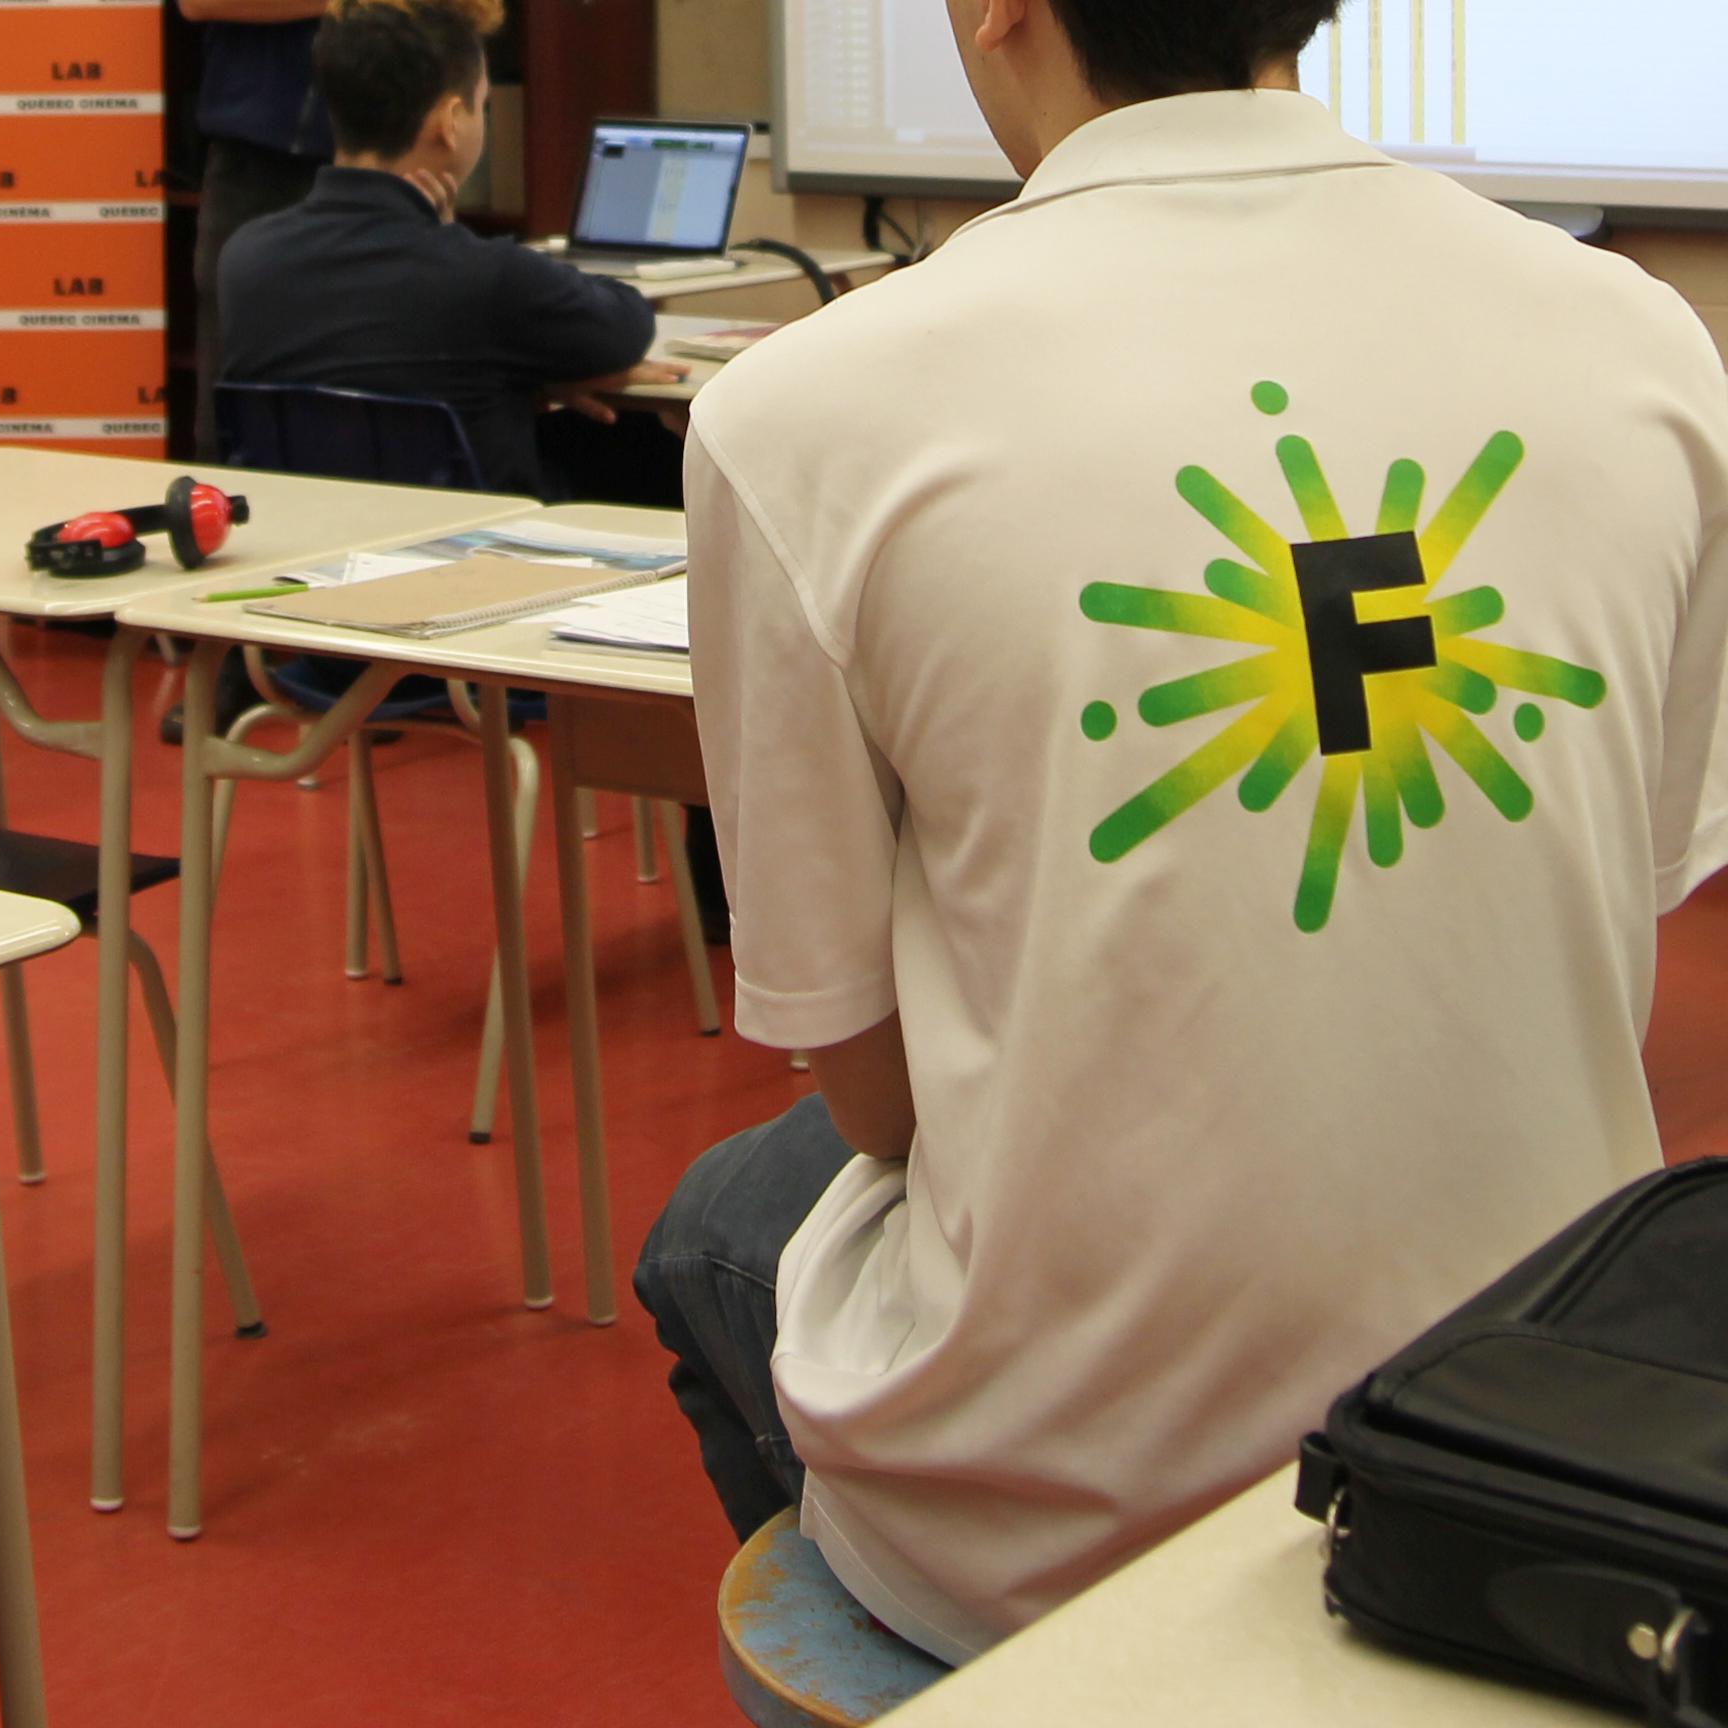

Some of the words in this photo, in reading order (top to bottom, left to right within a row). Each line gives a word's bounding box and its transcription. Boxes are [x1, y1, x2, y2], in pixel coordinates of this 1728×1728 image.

[52, 63, 102, 80] LAB
[54, 278, 104, 295] LAB
[1290, 531, 1437, 756] F
